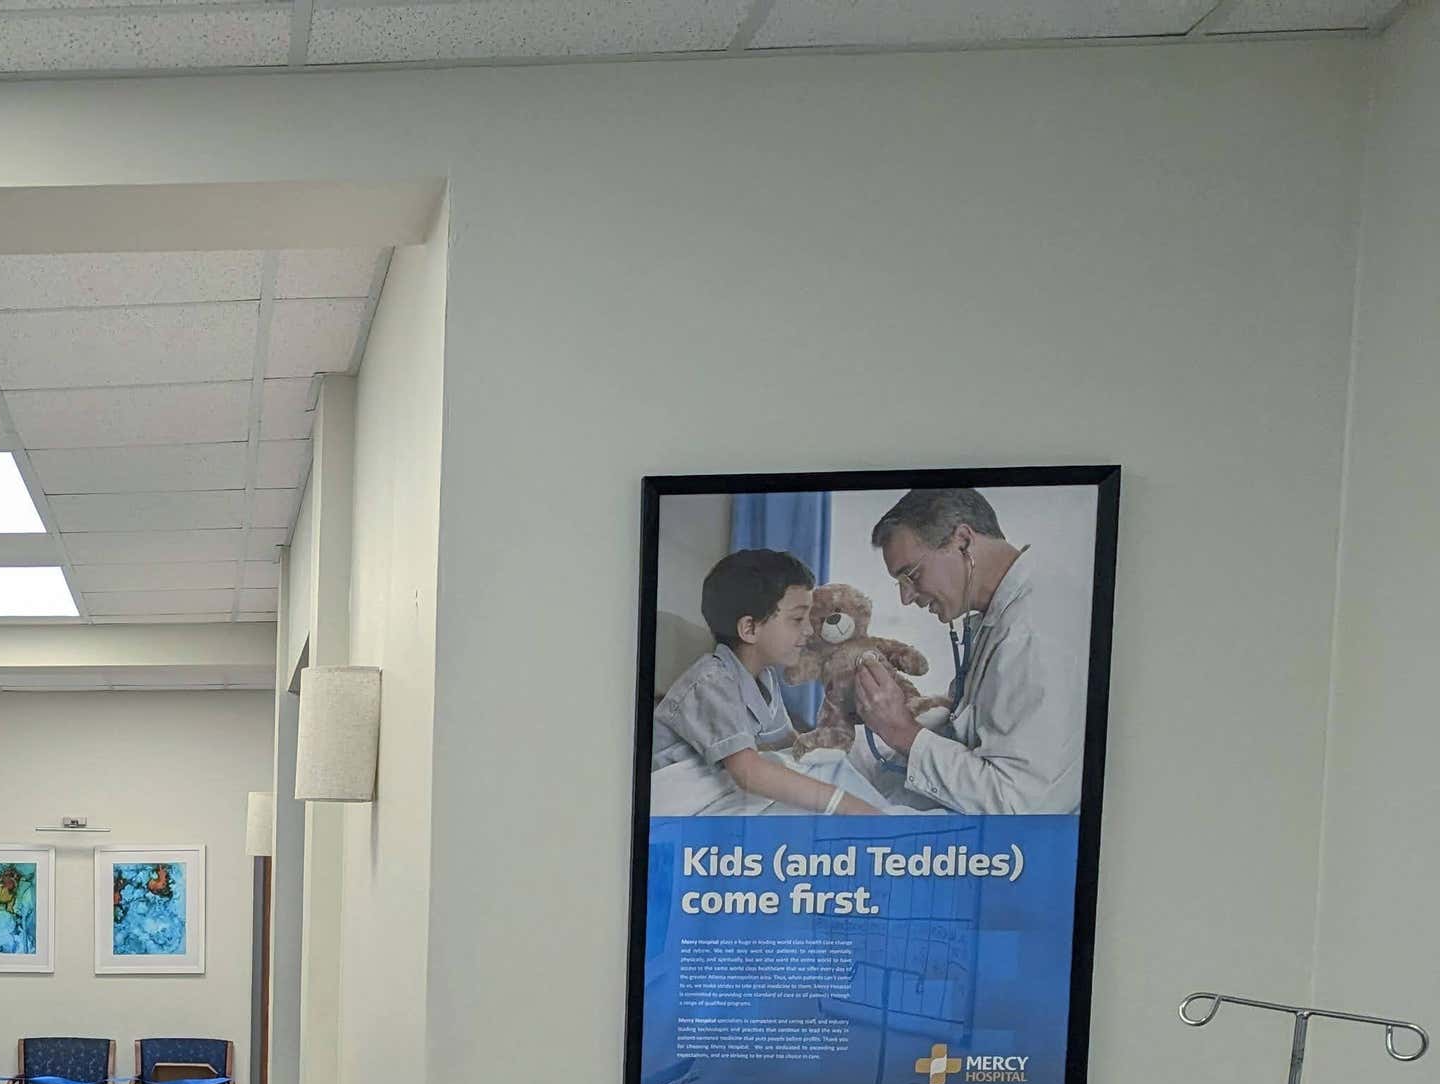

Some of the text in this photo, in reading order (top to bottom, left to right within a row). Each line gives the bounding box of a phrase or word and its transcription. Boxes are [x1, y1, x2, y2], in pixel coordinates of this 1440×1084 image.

[683, 844, 1024, 882] Kids (and Teddies)
[681, 883, 880, 915] come first.
[966, 1056, 1029, 1071] MERCY
[965, 1071, 1028, 1082] HOSPITAL
